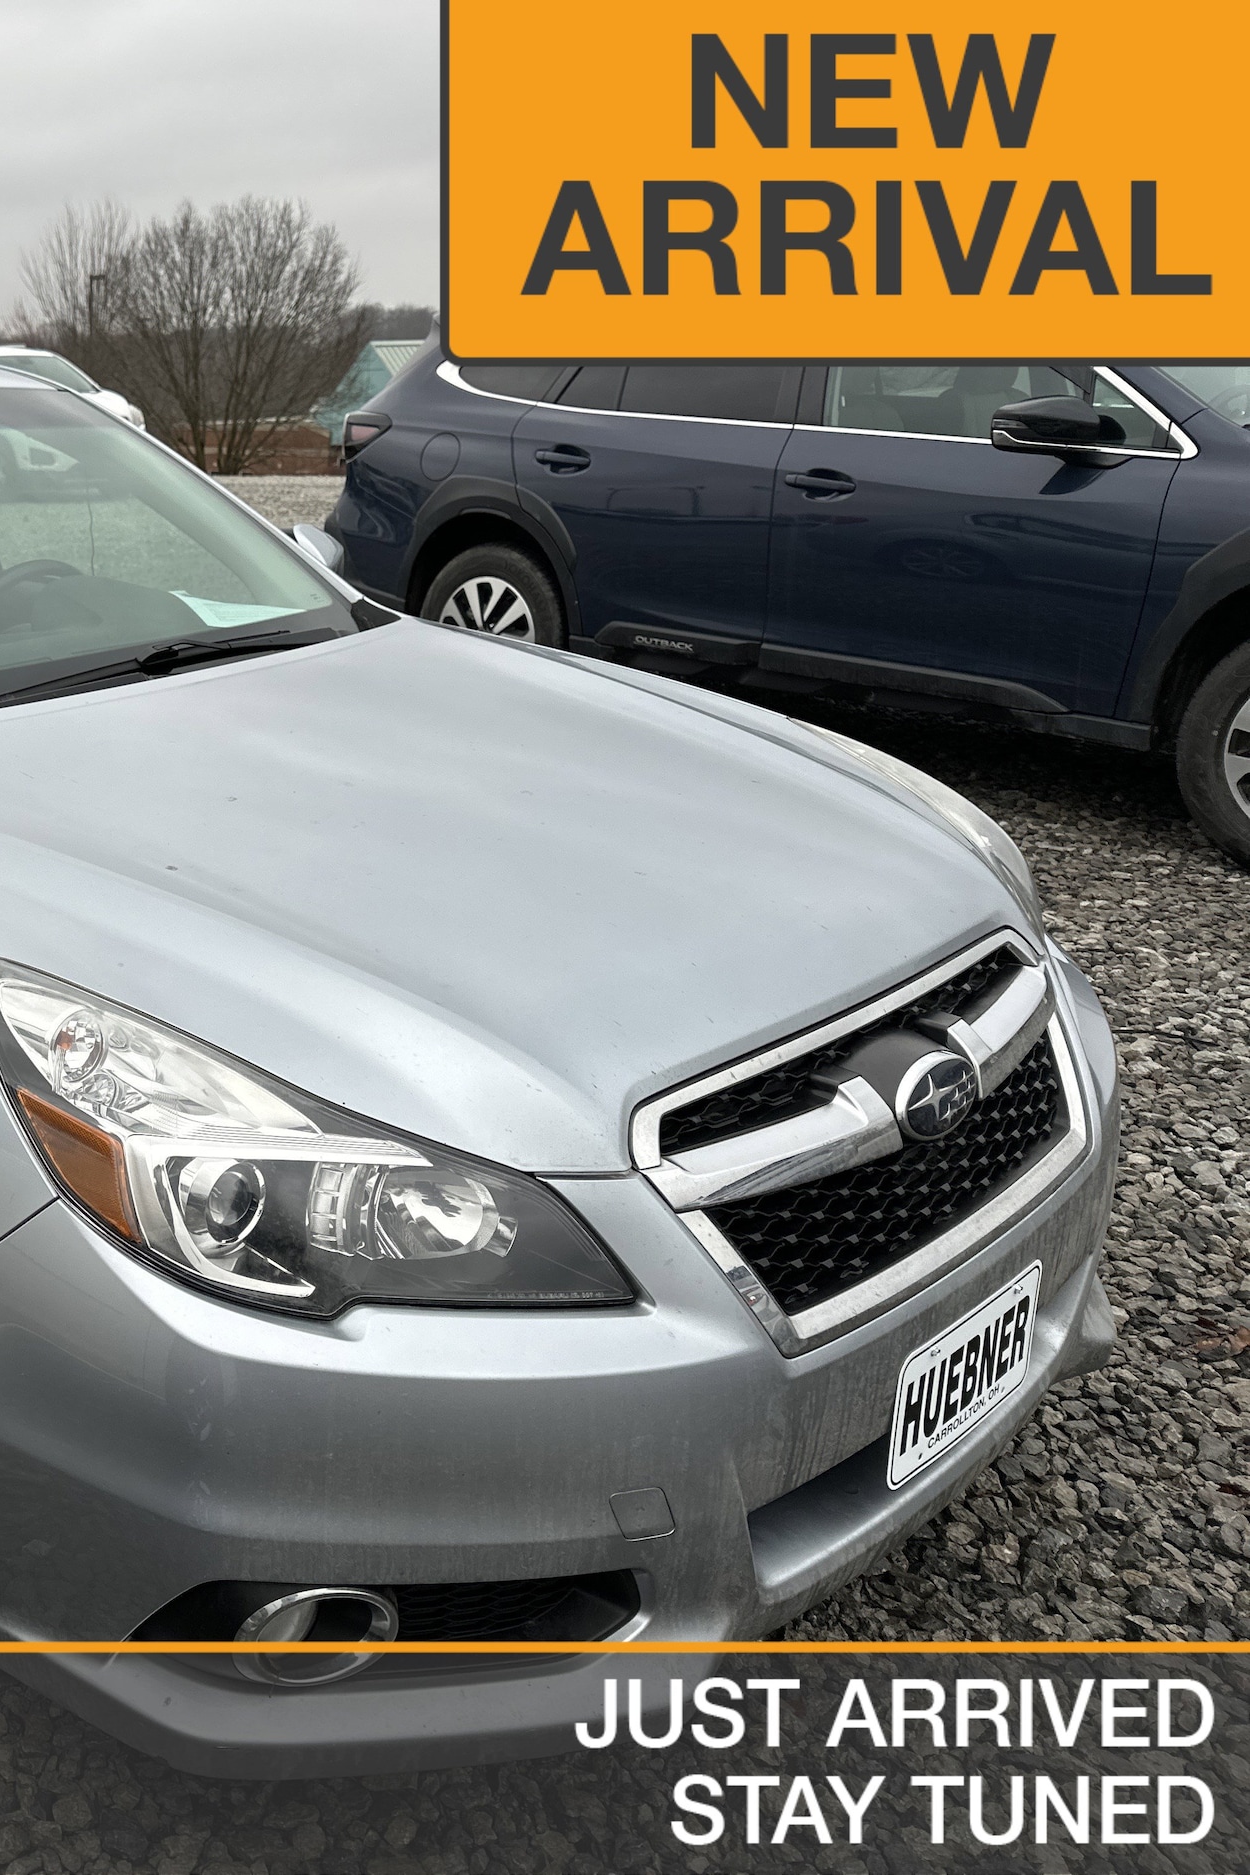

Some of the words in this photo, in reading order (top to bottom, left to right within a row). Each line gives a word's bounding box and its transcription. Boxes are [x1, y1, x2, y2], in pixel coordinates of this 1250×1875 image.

[635, 635, 694, 651] OUTBACK
[900, 1295, 1031, 1457] HUEBNER
[928, 1397, 986, 1448] CARROLLTON,
[988, 1384, 1000, 1400] OH
